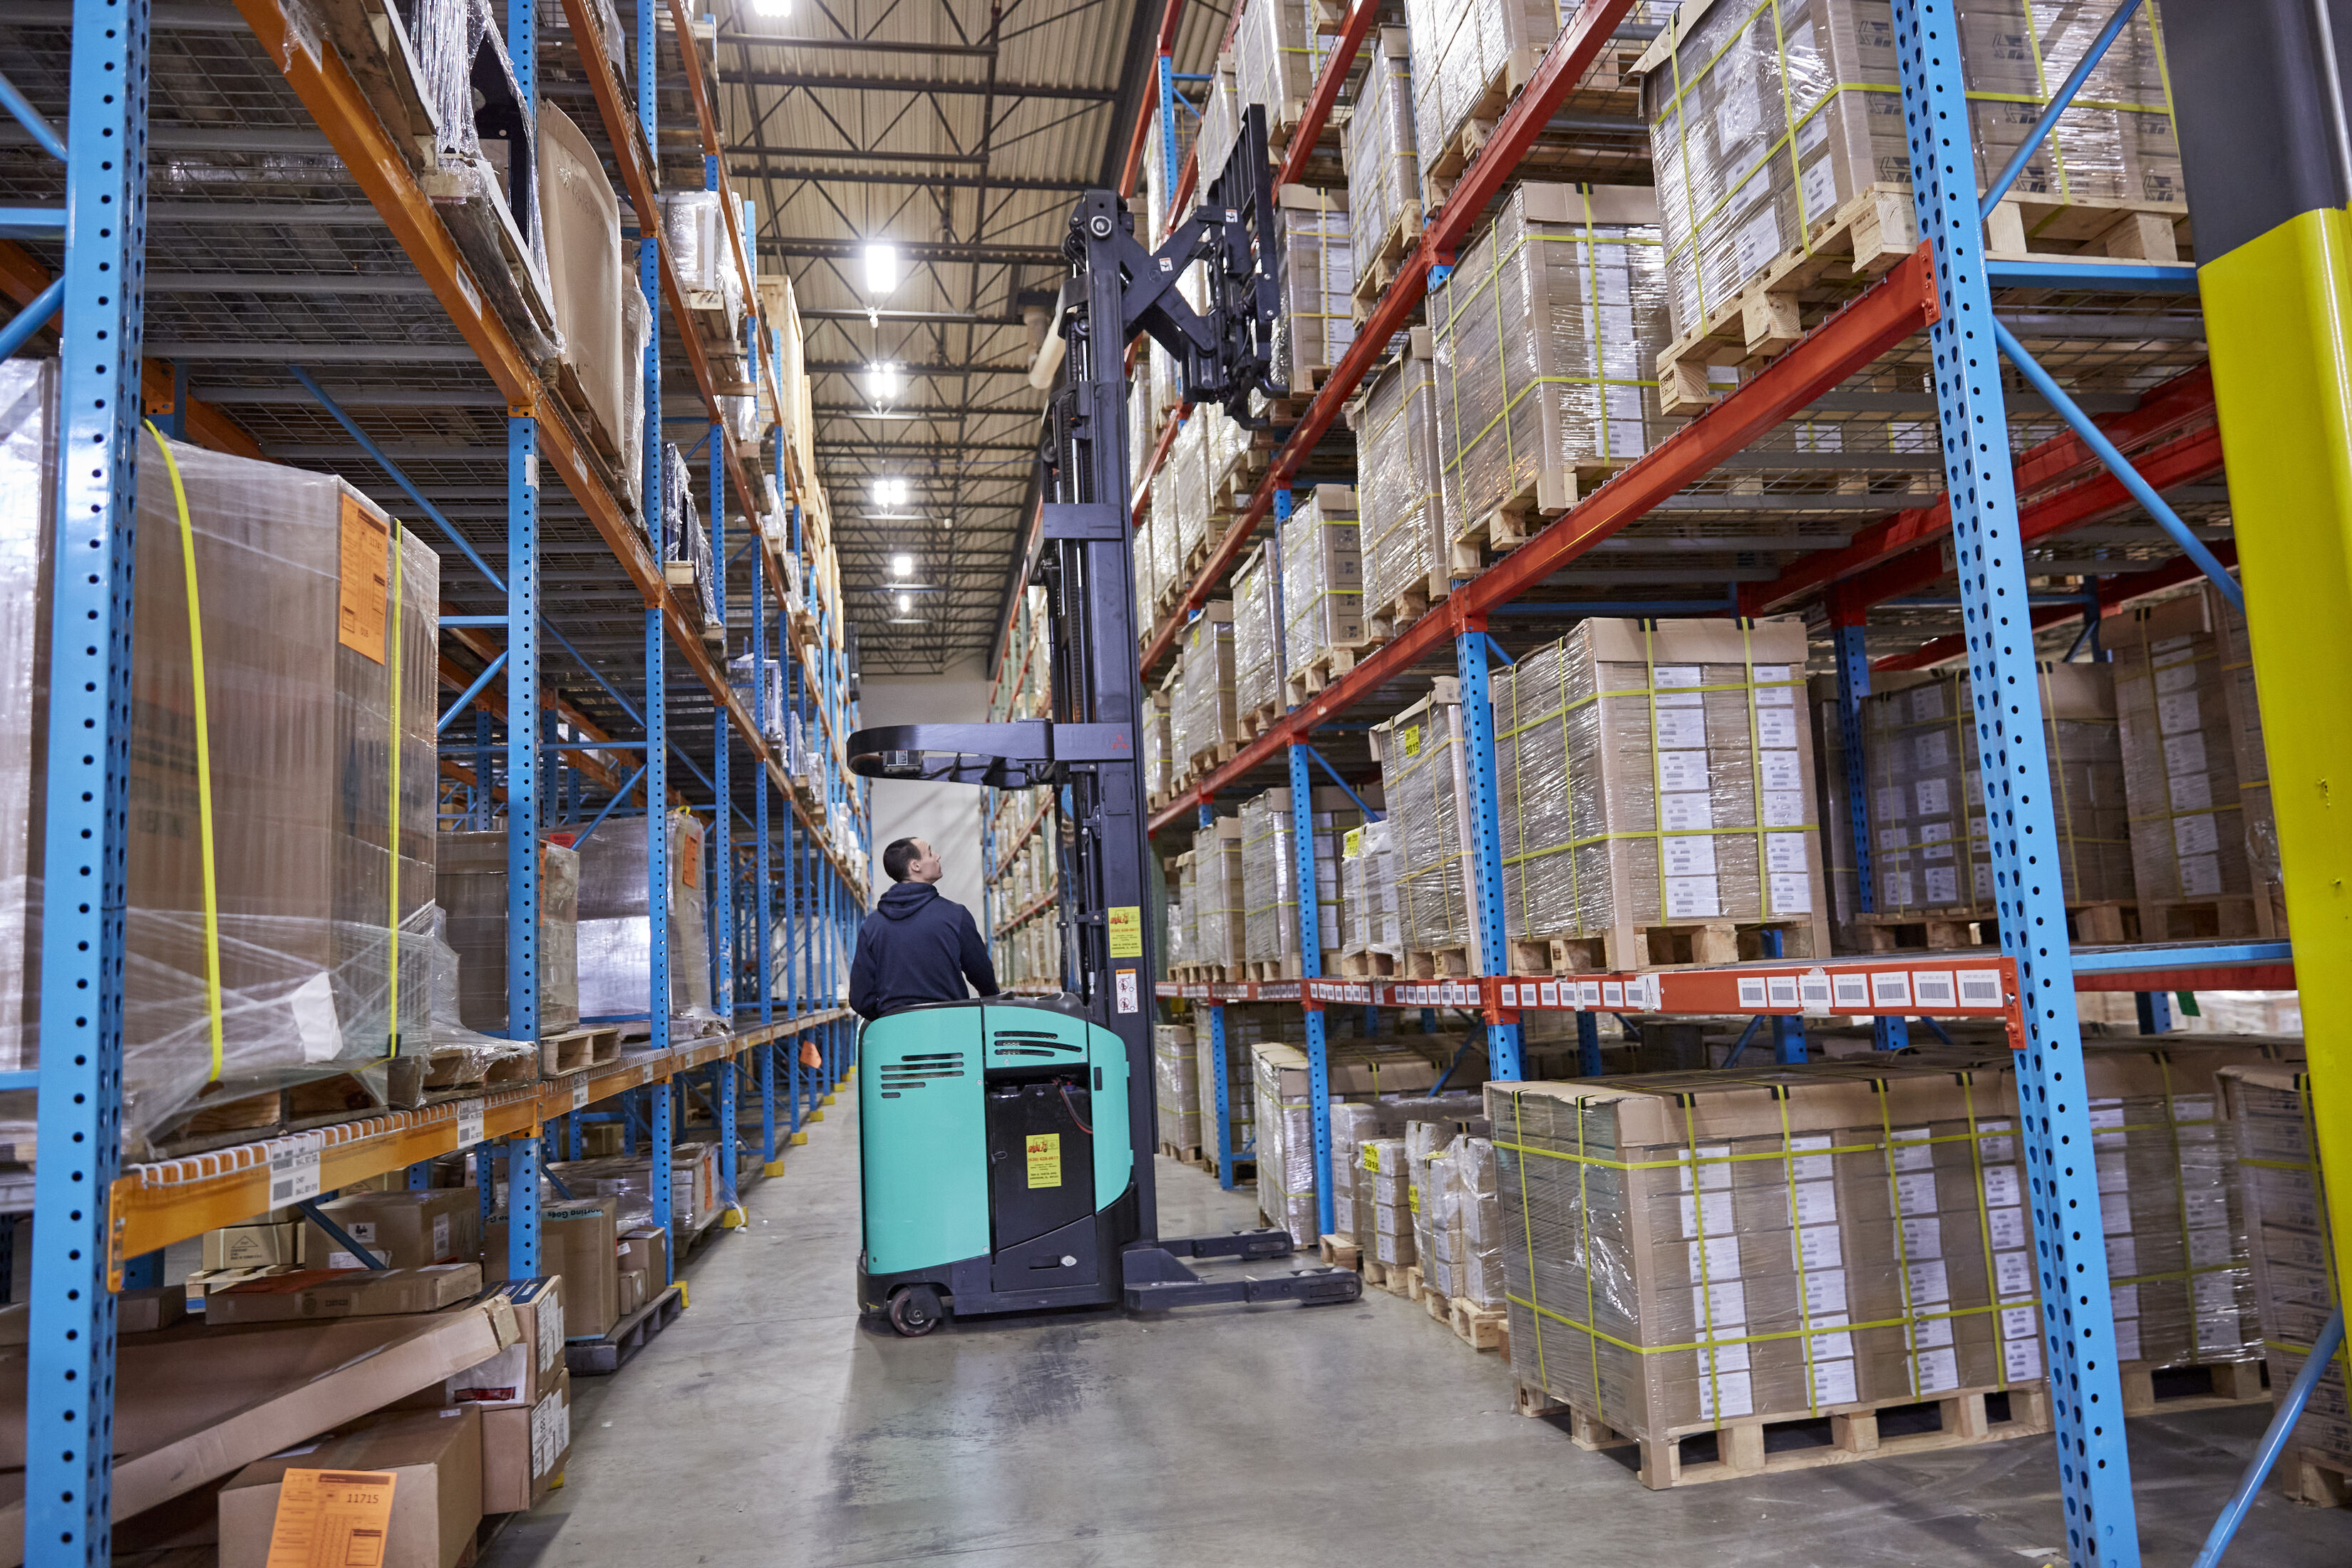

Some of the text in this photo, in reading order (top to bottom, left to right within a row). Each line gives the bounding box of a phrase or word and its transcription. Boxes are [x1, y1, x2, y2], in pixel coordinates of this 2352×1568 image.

[1405, 742, 1419, 755] 2019
[1363, 1158, 1379, 1170] 2018
[346, 1494, 379, 1504] 11715
